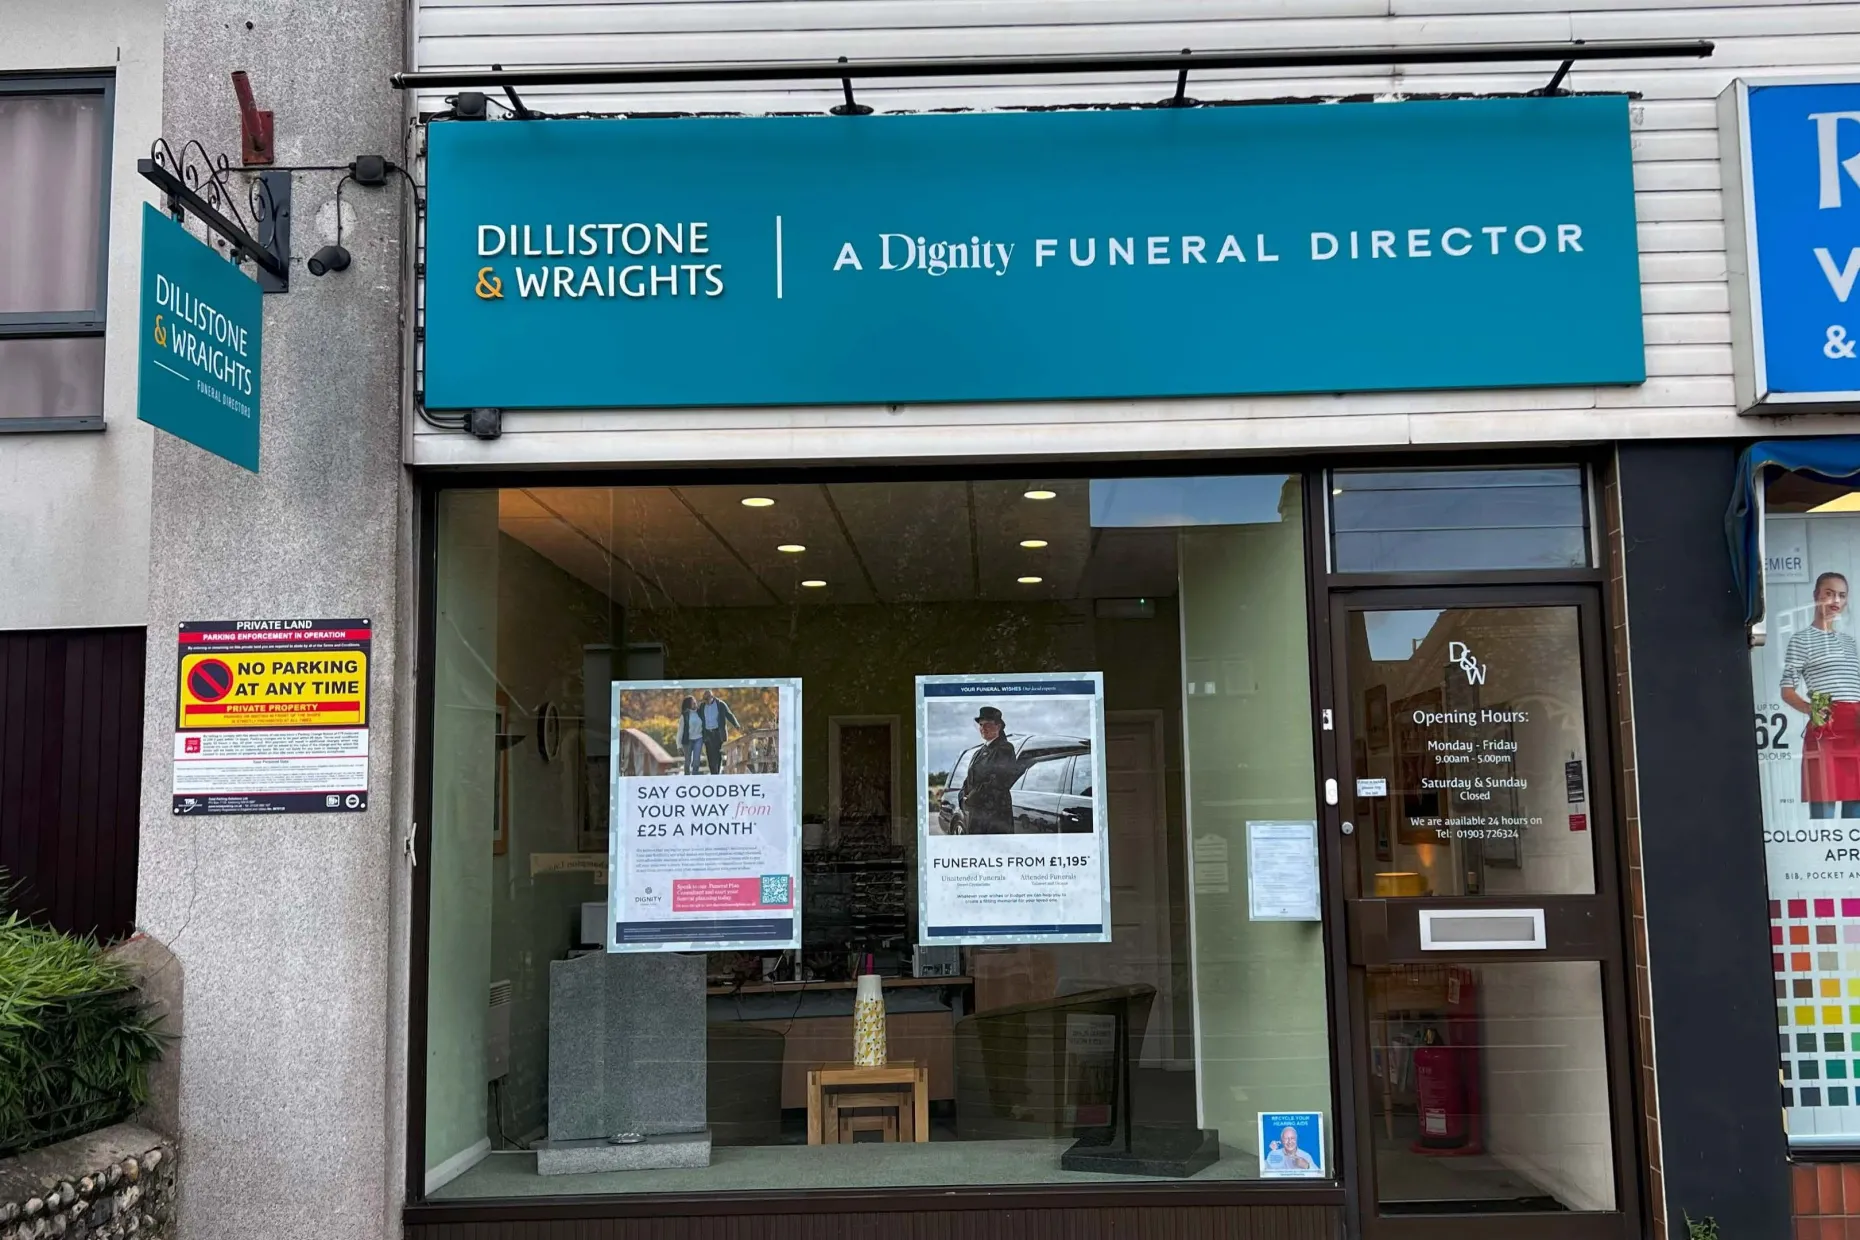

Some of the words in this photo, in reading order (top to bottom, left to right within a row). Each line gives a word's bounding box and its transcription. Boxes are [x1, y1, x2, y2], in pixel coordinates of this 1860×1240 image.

[1807, 110, 1860, 211] R
[477, 222, 709, 256] DILLISTONE
[833, 242, 863, 271] A
[878, 233, 1015, 276] Dignity
[1035, 233, 1279, 267] FUNERAL
[1311, 223, 1584, 261] DIRECTOR
[475, 266, 504, 299] &
[515, 263, 724, 298] WRAIGHTS
[1813, 247, 1860, 303] V
[156, 273, 247, 358] DILLISTONE
[1823, 325, 1857, 360] &
[154, 314, 167, 349] &
[171, 323, 252, 396] WRAIGHTS
[197, 379, 222, 404] FUNERAL
[222, 391, 251, 419] DIRECTORS
[1765, 557, 1802, 570] EMIER
[237, 621, 281, 630] PRIVATE
[284, 620, 312, 629] LAND
[203, 632, 235, 640] PARKING
[238, 632, 293, 640] ENFORCEMENT
[304, 631, 346, 639] OPERATION
[238, 662, 265, 676] NO
[272, 660, 358, 675] PARKING
[235, 683, 259, 696] AT
[265, 682, 306, 695] ANY
[312, 681, 359, 694] TIME
[226, 704, 267, 712] PRIVATE
[268, 703, 318, 711] PROPERTY
[1413, 710, 1477, 726] Opening
[1481, 710, 1529, 723] Hours:
[1755, 713, 1789, 749] 62
[1427, 740, 1473, 752] Monday
[1482, 739, 1518, 752] Friday
[1435, 755, 1470, 764] 9.00am
[1477, 754, 1511, 765] 5.00pm
[1758, 753, 1792, 761] OLOURS
[1421, 777, 1471, 790] Saturday
[1474, 778, 1483, 788] &
[1485, 777, 1528, 789] Sunday
[637, 786, 669, 799] SAY
[675, 784, 765, 799] GOODBYE,
[1459, 791, 1491, 801] Closed
[637, 805, 685, 818] YOUR
[691, 804, 729, 817] WAY
[731, 801, 772, 820] from
[1410, 817, 1424, 826] We
[1427, 818, 1442, 826] are
[1444, 816, 1486, 826] available
[1488, 817, 1499, 826] 24
[1501, 816, 1528, 826] hours
[1530, 817, 1543, 825] on
[637, 824, 667, 837] £25
[673, 823, 684, 836] A
[1436, 829, 1452, 838] Tel:
[1456, 829, 1484, 838] 01903
[1486, 829, 1519, 839] 726324
[1763, 829, 1843, 843] COLOURS
[1848, 828, 1860, 842] C
[933, 857, 1003, 869] FUNERALS
[1007, 856, 1045, 868] FROM
[1825, 848, 1860, 862] APR
[1785, 872, 1803, 881] BIB,
[1807, 871, 1844, 880] POCKET
[1848, 871, 1860, 879] AN
